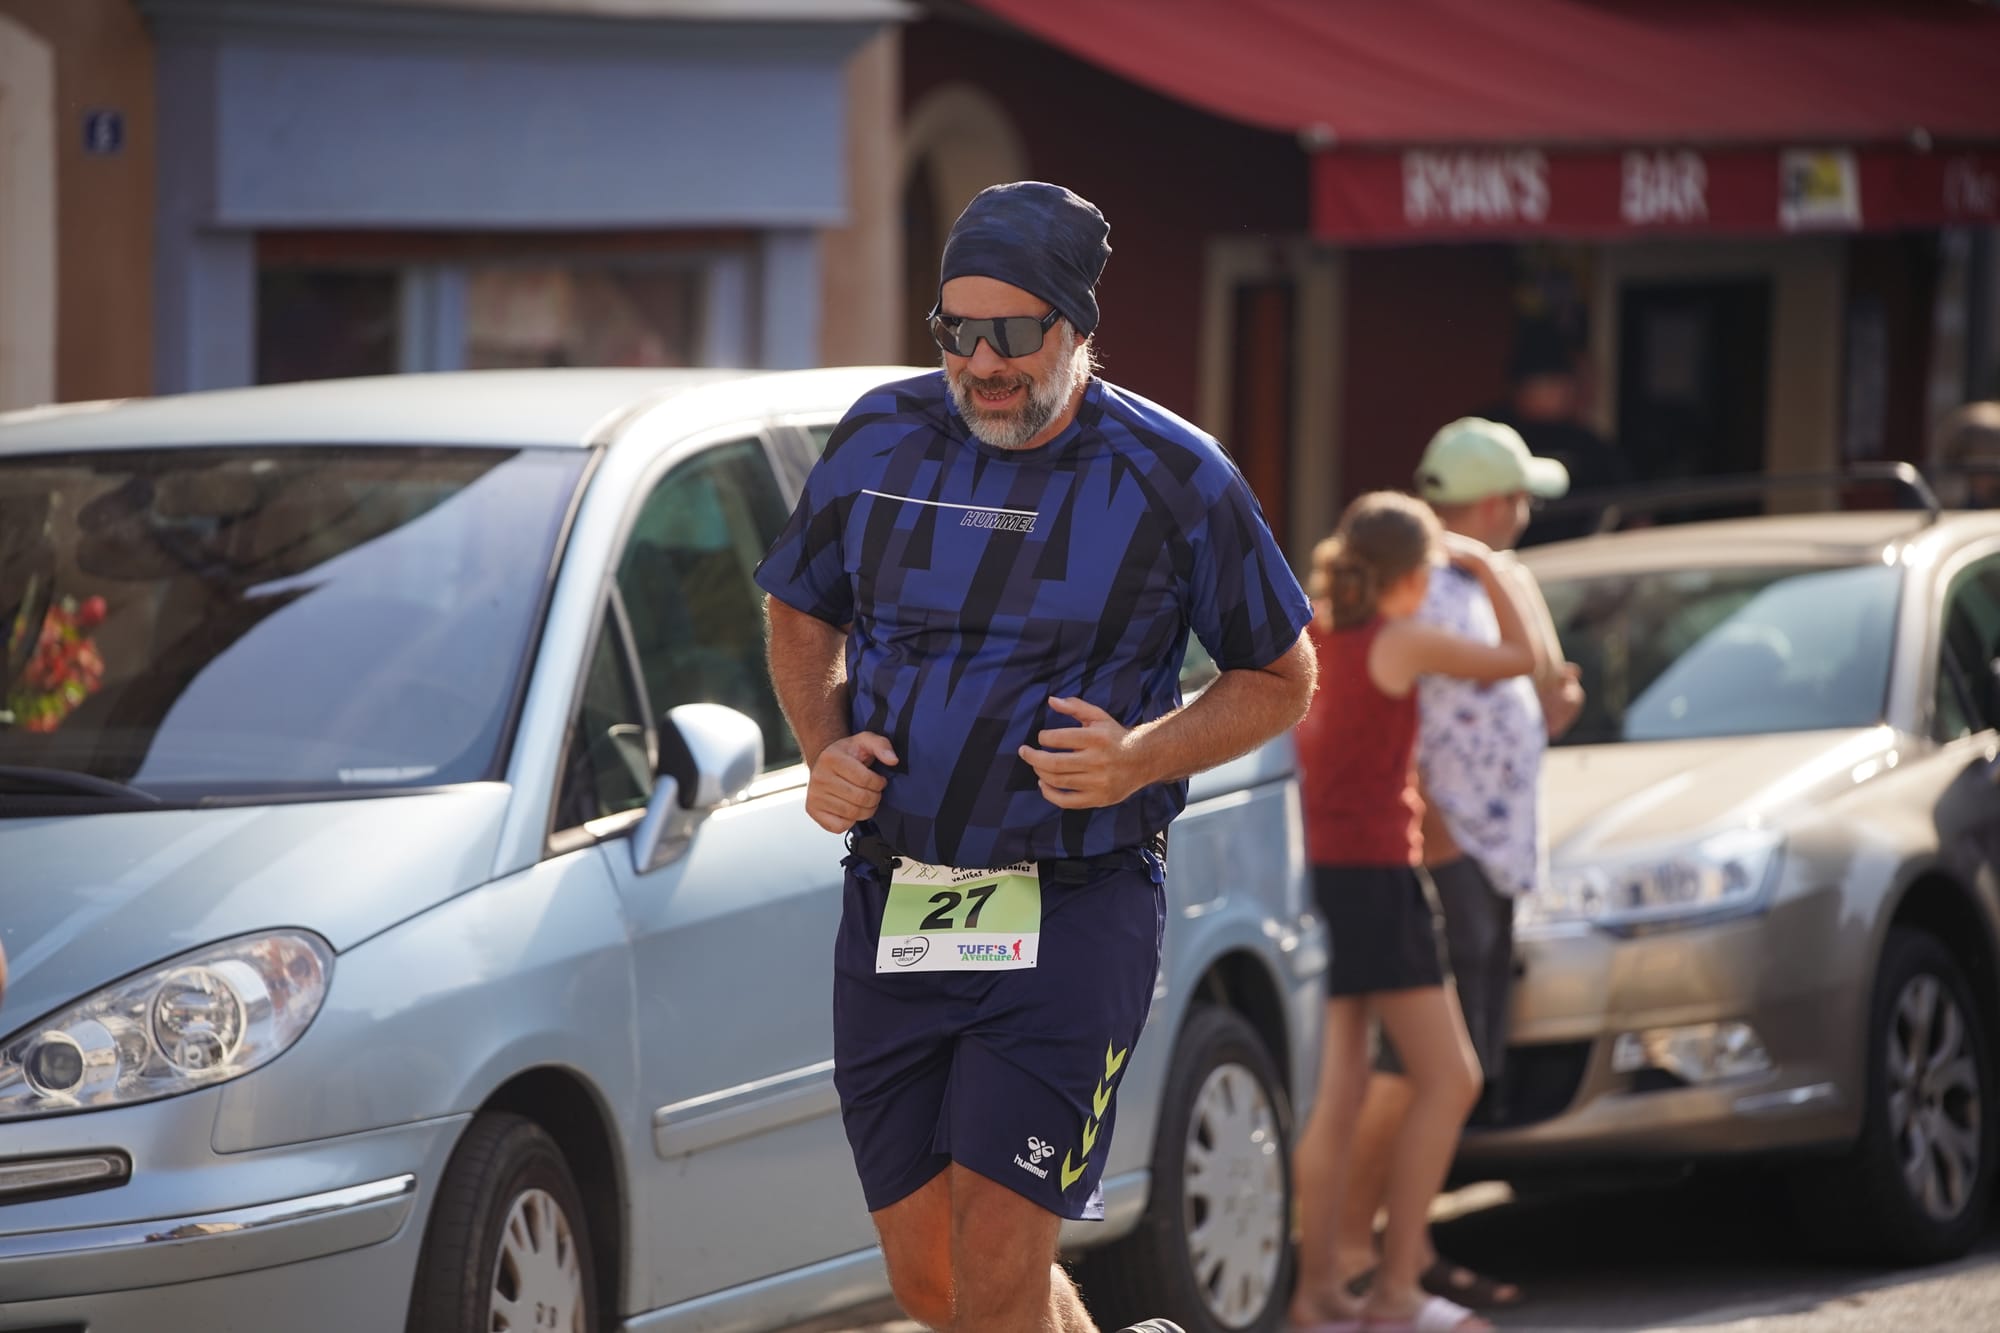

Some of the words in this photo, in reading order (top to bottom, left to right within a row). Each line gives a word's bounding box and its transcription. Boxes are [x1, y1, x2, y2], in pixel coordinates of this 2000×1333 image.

[1620, 149, 1707, 225] BAR
[960, 511, 1037, 533] HUMMEL
[919, 884, 998, 931] 27
[891, 947, 924, 958] BFP
[957, 944, 1008, 955] TUFF'S
[961, 953, 1013, 962] Aventure
[1013, 1153, 1049, 1180] hummel
